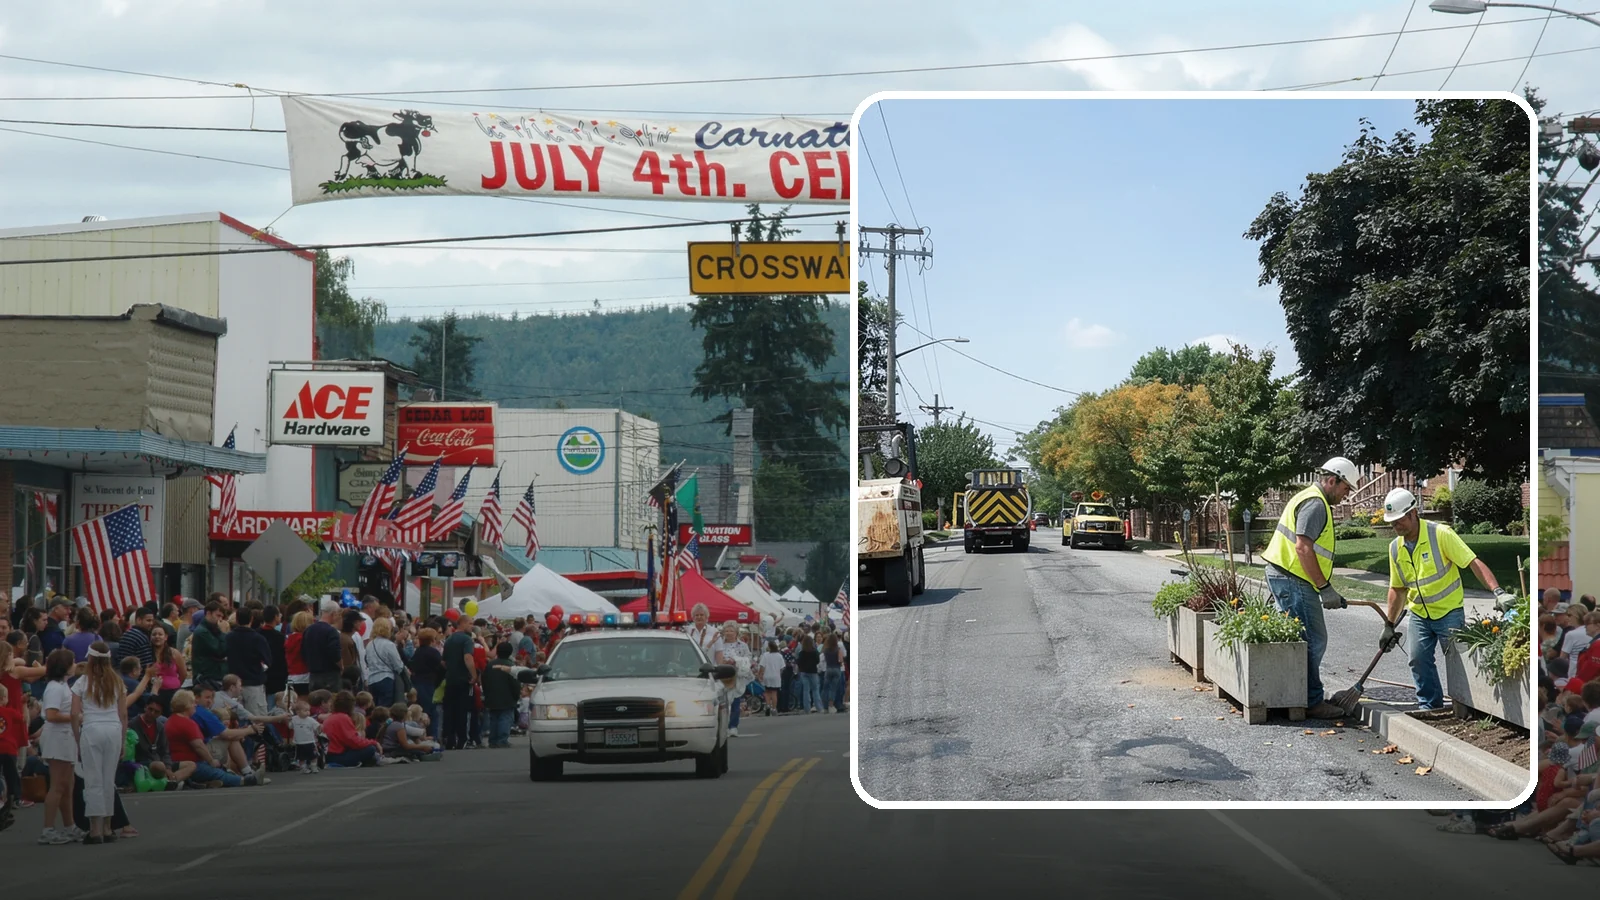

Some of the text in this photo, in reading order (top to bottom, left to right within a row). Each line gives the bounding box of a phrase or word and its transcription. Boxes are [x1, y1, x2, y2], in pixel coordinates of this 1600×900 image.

[481, 141, 604, 192] JULY
[632, 150, 746, 198] 4th.
[697, 254, 850, 279] CROSSWA
[283, 380, 373, 420] ACE
[406, 410, 452, 422] CEDAR
[283, 421, 371, 436] Hardware
[353, 467, 387, 480] Simpl
[95, 484, 124, 495] Vincent
[126, 485, 136, 495] de
[137, 485, 155, 496] Paul
[688, 526, 742, 535] CRNATION
[699, 535, 730, 543] GLASS
